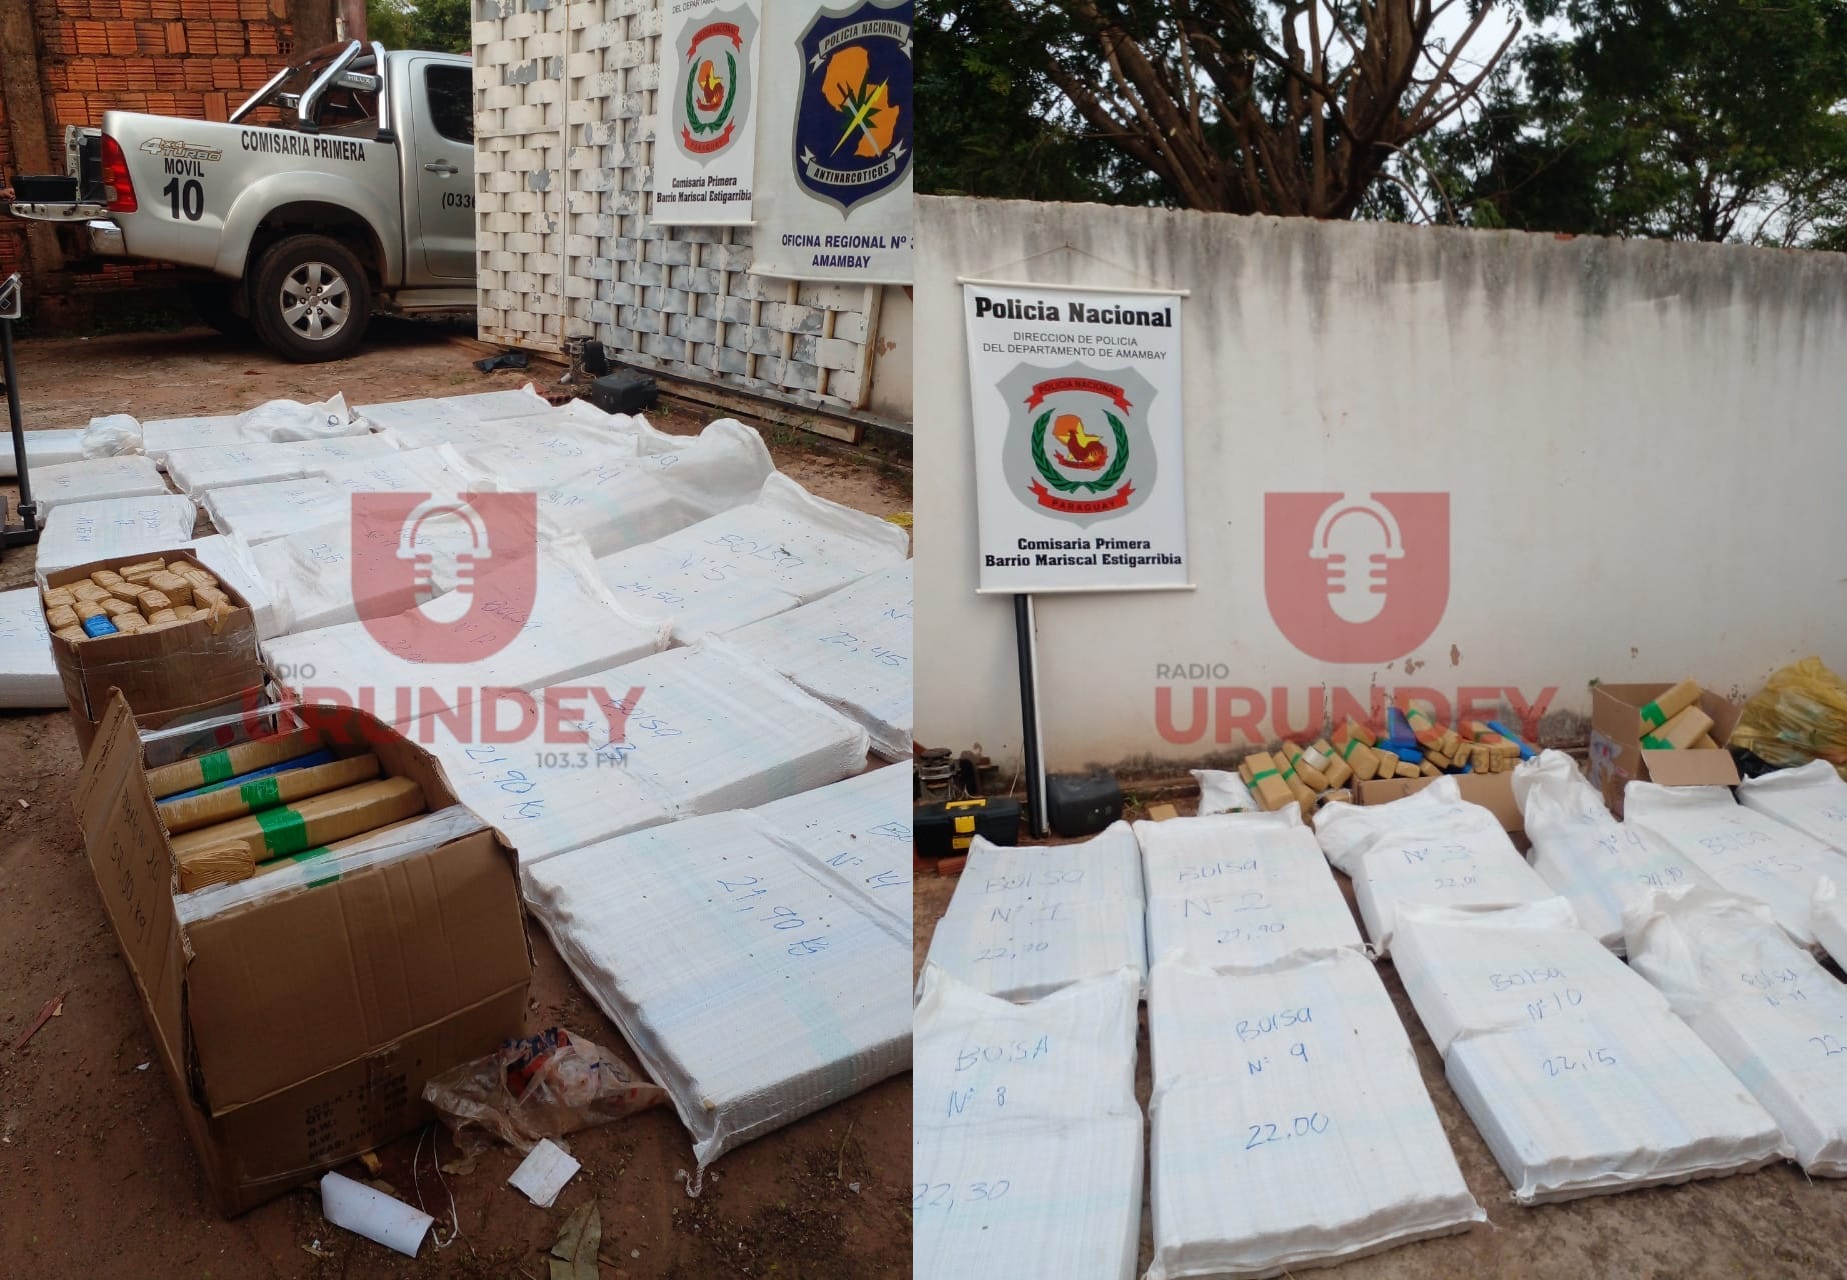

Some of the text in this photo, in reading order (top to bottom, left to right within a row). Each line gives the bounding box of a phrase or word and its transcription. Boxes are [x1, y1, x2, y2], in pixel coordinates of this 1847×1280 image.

[824, 22, 902, 49] POLICIA NACIONAL
[241, 129, 366, 162] COMISARIA PRIMERA
[164, 157, 205, 177] MOVIL
[813, 163, 889, 184] ANTINARCOTICOS
[672, 176, 737, 188] Comisaria Primera
[163, 176, 205, 221] 10
[656, 189, 752, 205] Barrio Mariscal Estigarribia
[781, 233, 821, 248] OFICINA
[824, 234, 886, 249] REGIONAL
[812, 254, 871, 269] AMAMBAY
[975, 297, 1172, 327] Policia Nacional
[1013, 332, 1138, 346] DIRECCION DE POLICIA
[983, 343, 1167, 360] DEL DEPARTAMENTO DE AMAMBAY
[1051, 500, 1116, 512] PARAGUAY
[1017, 538, 1151, 550] Comisaria Primera
[985, 553, 1182, 568] Barrio Mariscal Estigarribia
[1290, 1042, 1310, 1064] 9
[996, 1085, 1008, 1108] 8
